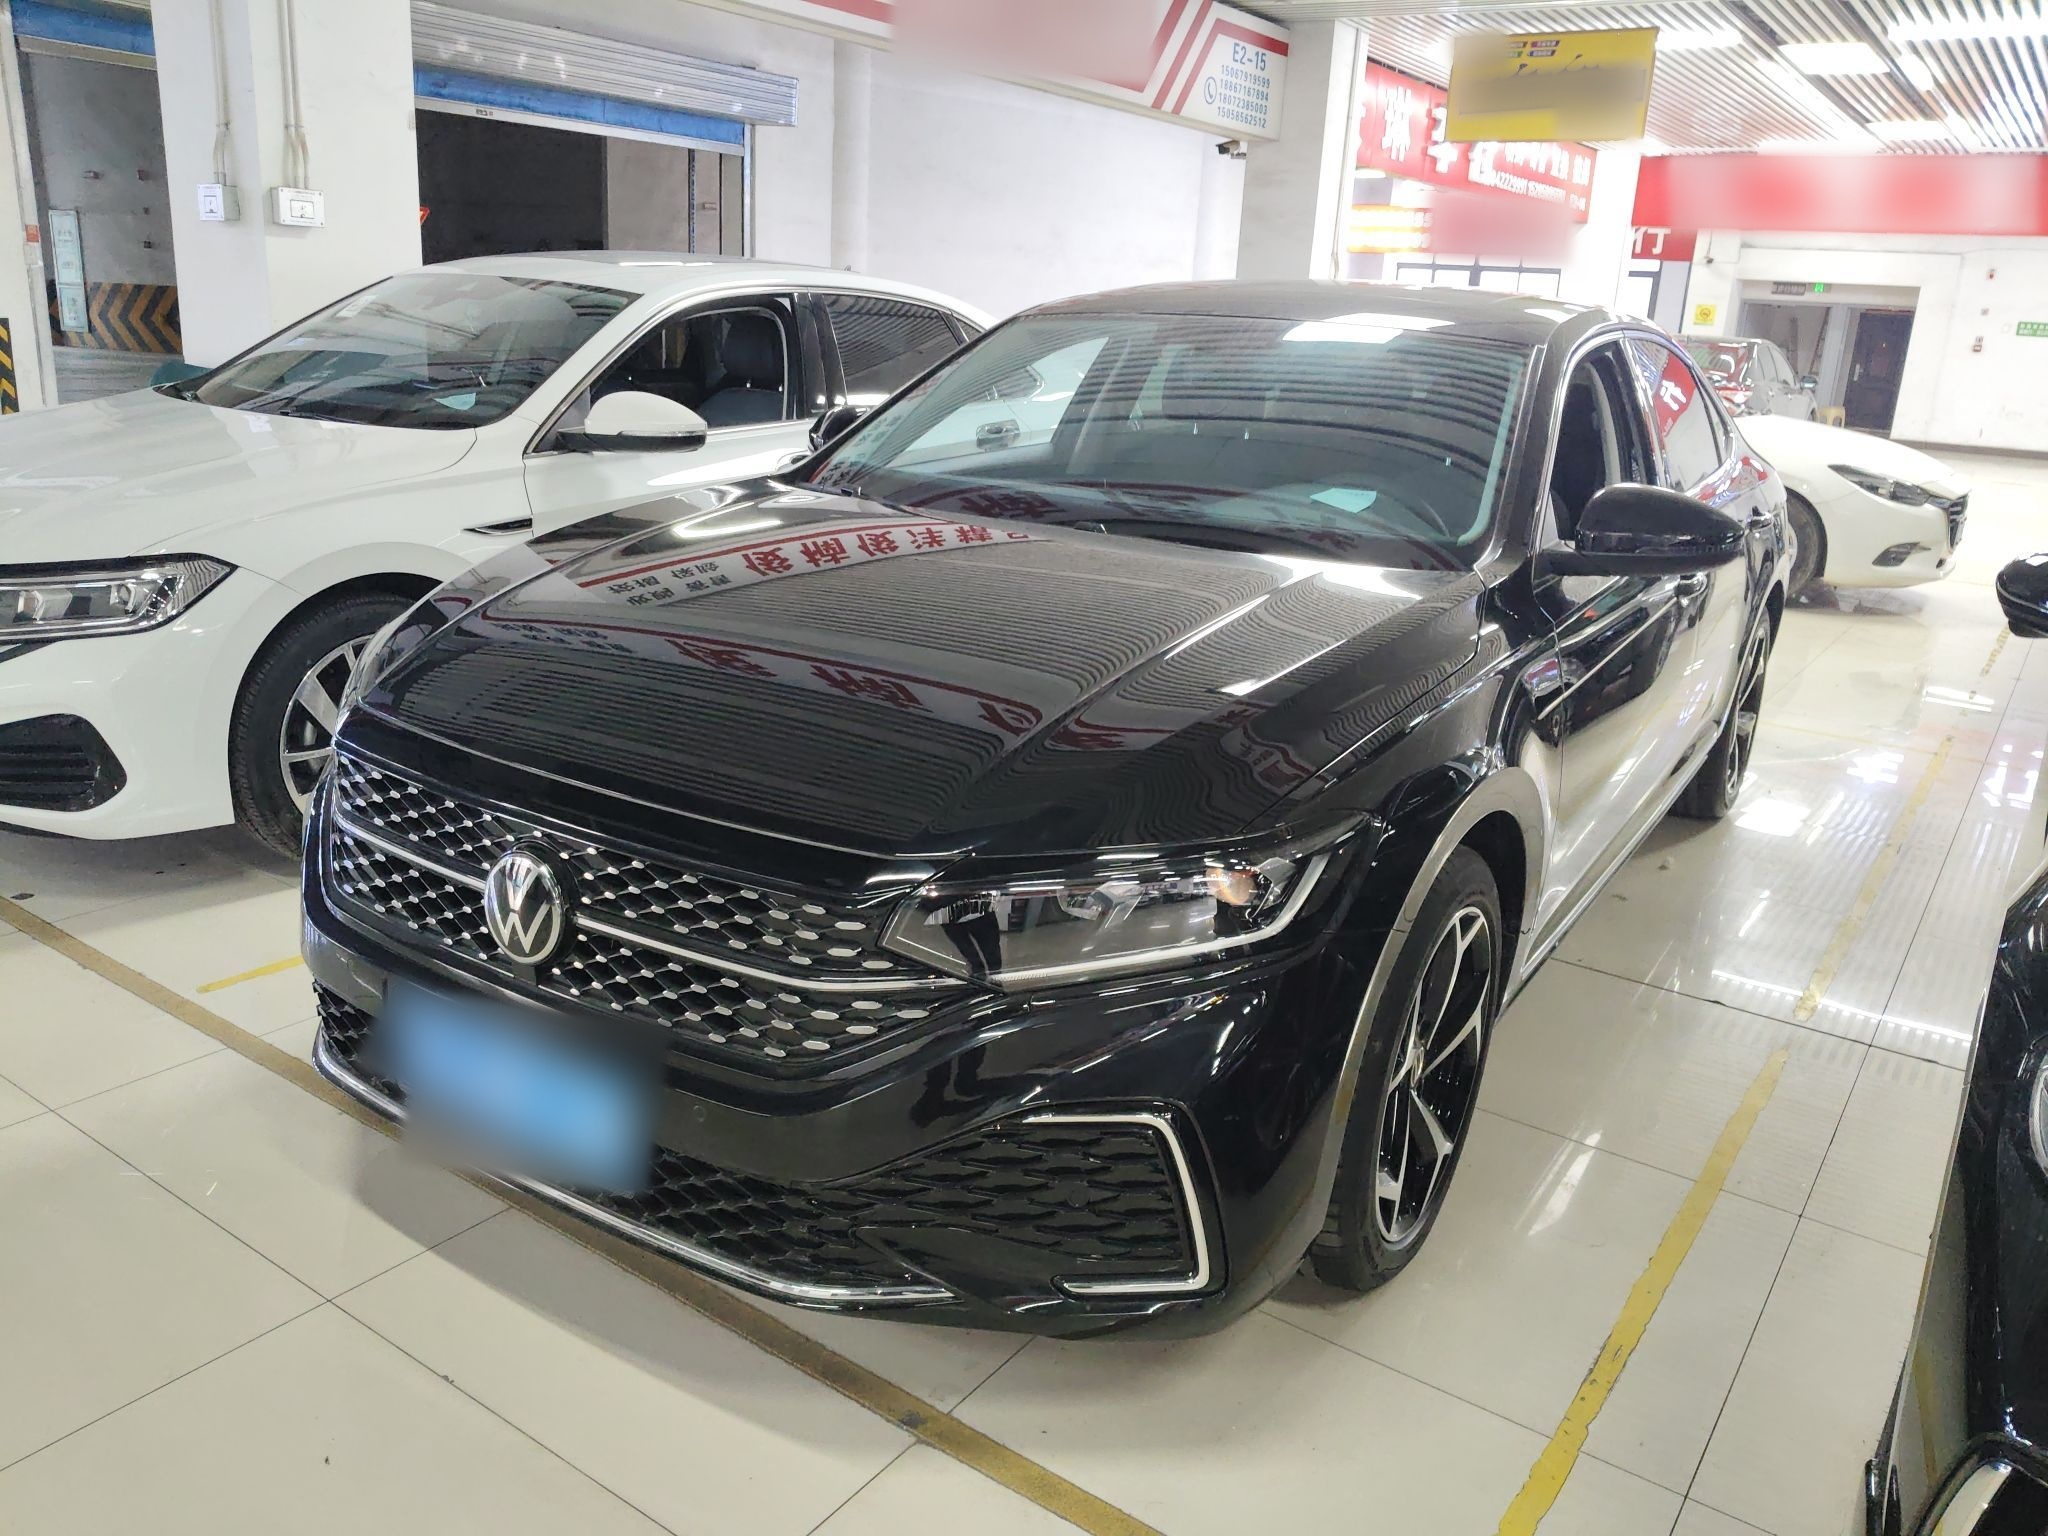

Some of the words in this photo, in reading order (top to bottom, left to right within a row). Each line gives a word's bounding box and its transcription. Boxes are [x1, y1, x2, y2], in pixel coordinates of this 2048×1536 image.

[1232, 42, 1267, 71] E2-15
[1220, 64, 1270, 89] 15067919599
[1217, 106, 1267, 128] 15058562512
